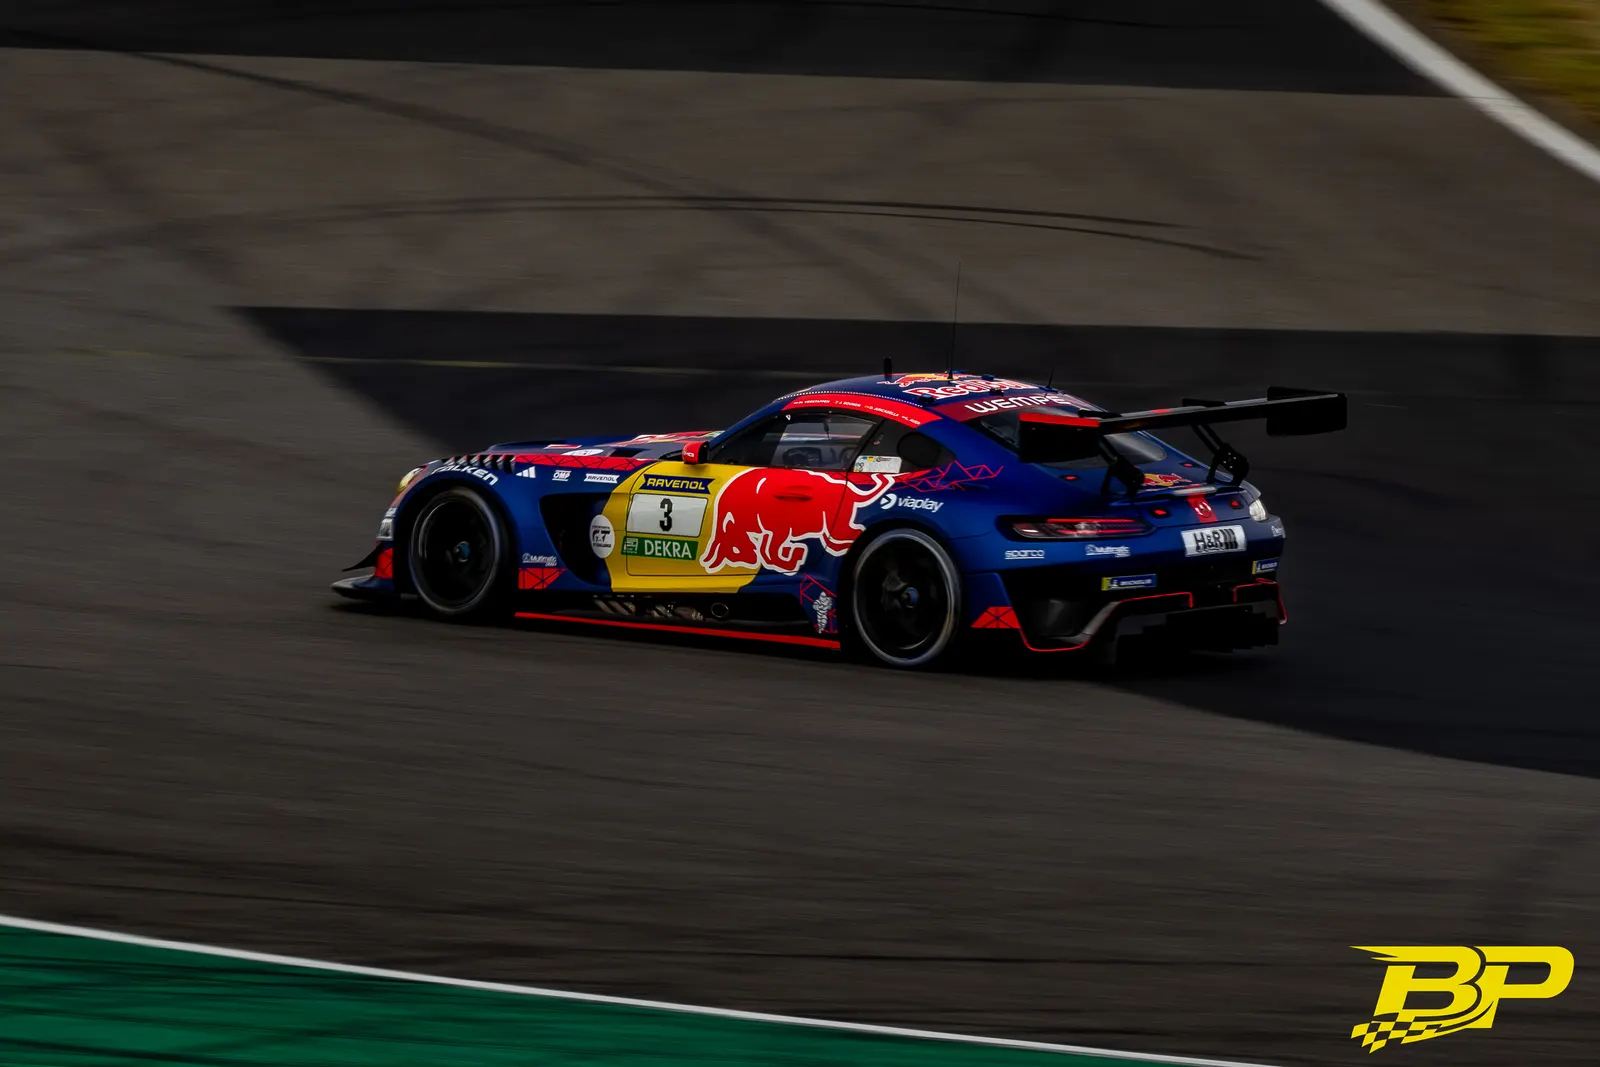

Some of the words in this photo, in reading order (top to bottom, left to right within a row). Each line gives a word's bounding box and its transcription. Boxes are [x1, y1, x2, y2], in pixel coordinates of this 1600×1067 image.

[964, 395, 1072, 413] WEMPE
[431, 464, 499, 486] FALKEN
[587, 474, 616, 483] RAVENOL
[646, 478, 706, 491] RAVENOL
[898, 495, 944, 513] viaplay
[659, 498, 673, 531] 3
[644, 540, 692, 559] DEKRA
[1005, 549, 1046, 558] sparco
